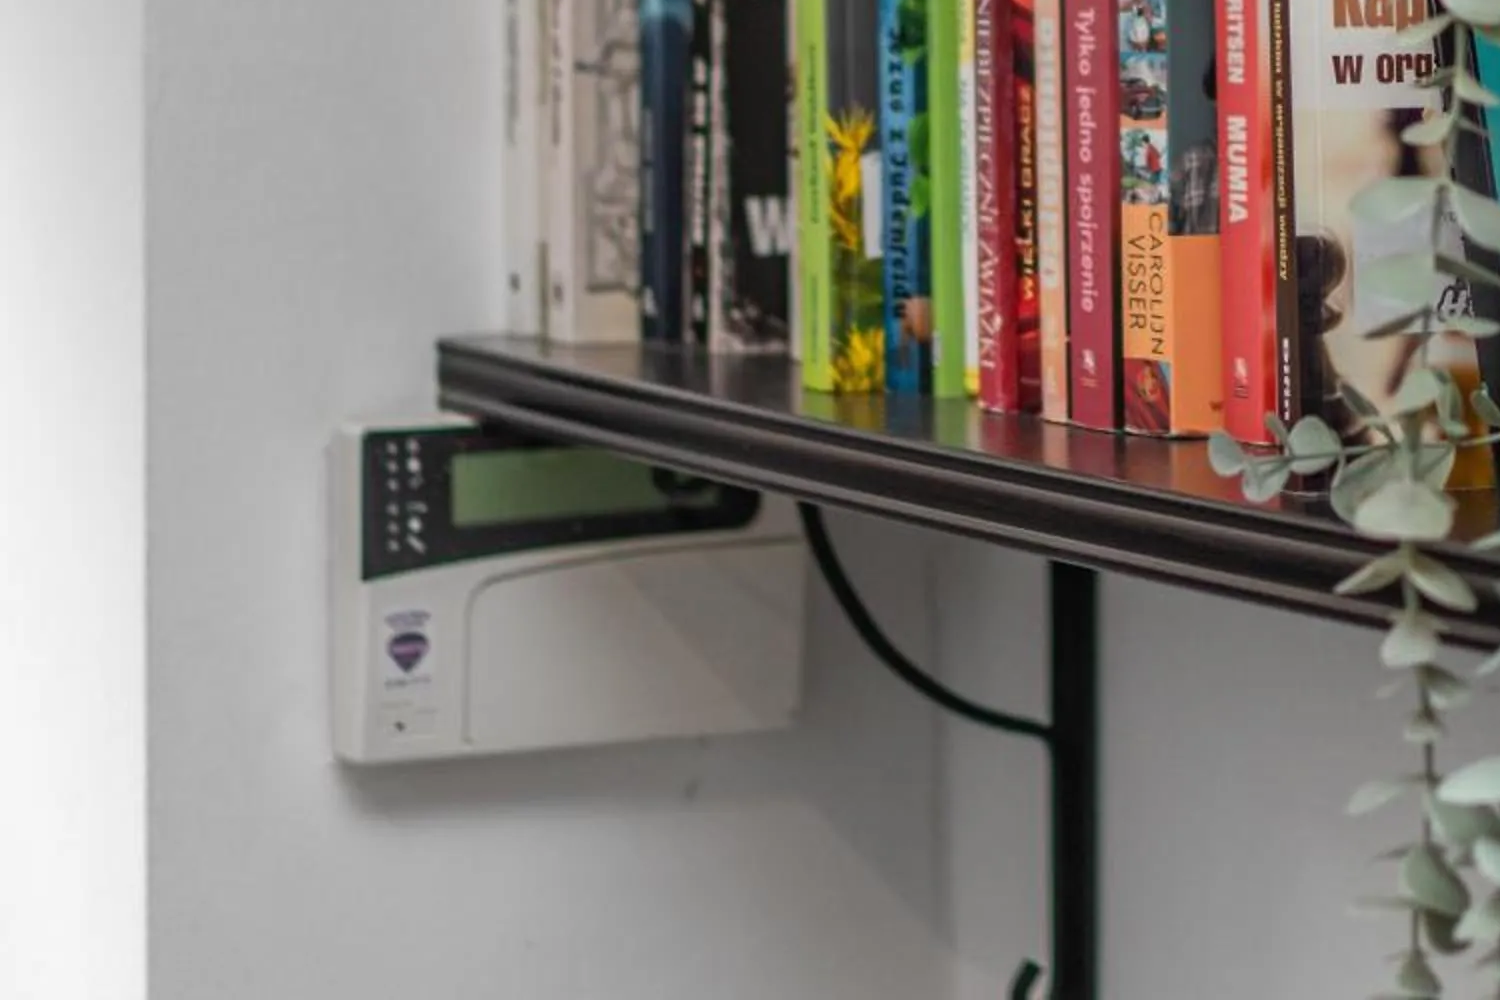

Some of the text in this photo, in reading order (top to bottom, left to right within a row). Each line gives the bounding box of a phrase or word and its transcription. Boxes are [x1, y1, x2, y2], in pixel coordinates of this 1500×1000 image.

[1332, 55, 1363, 85] w
[1074, 7, 1097, 313] Tylko jedno spojrzenie
[1227, 115, 1249, 224] MUMIA
[1127, 235, 1147, 330] VISSER
[1149, 211, 1165, 356] CAROLIJN
